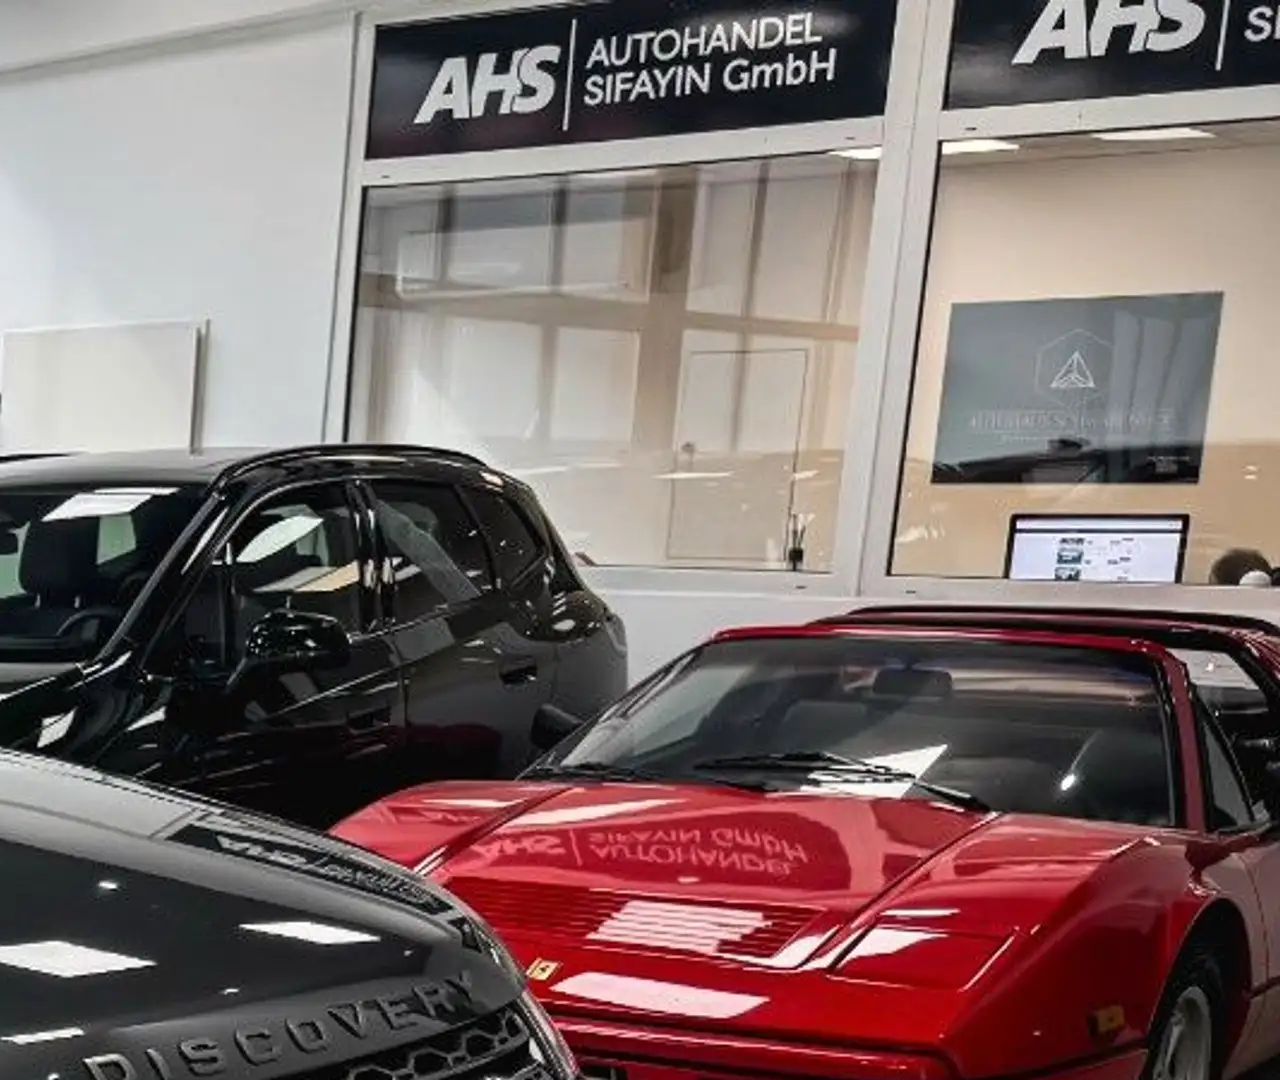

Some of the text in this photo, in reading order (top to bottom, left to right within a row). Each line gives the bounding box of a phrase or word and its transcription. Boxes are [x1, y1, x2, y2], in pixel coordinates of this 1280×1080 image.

[585, 12, 824, 70] AUTOHANDEL
[1011, 0, 1206, 66] AHS
[413, 45, 562, 124] AHS
[583, 47, 838, 107] SIFAYIN GmbH
